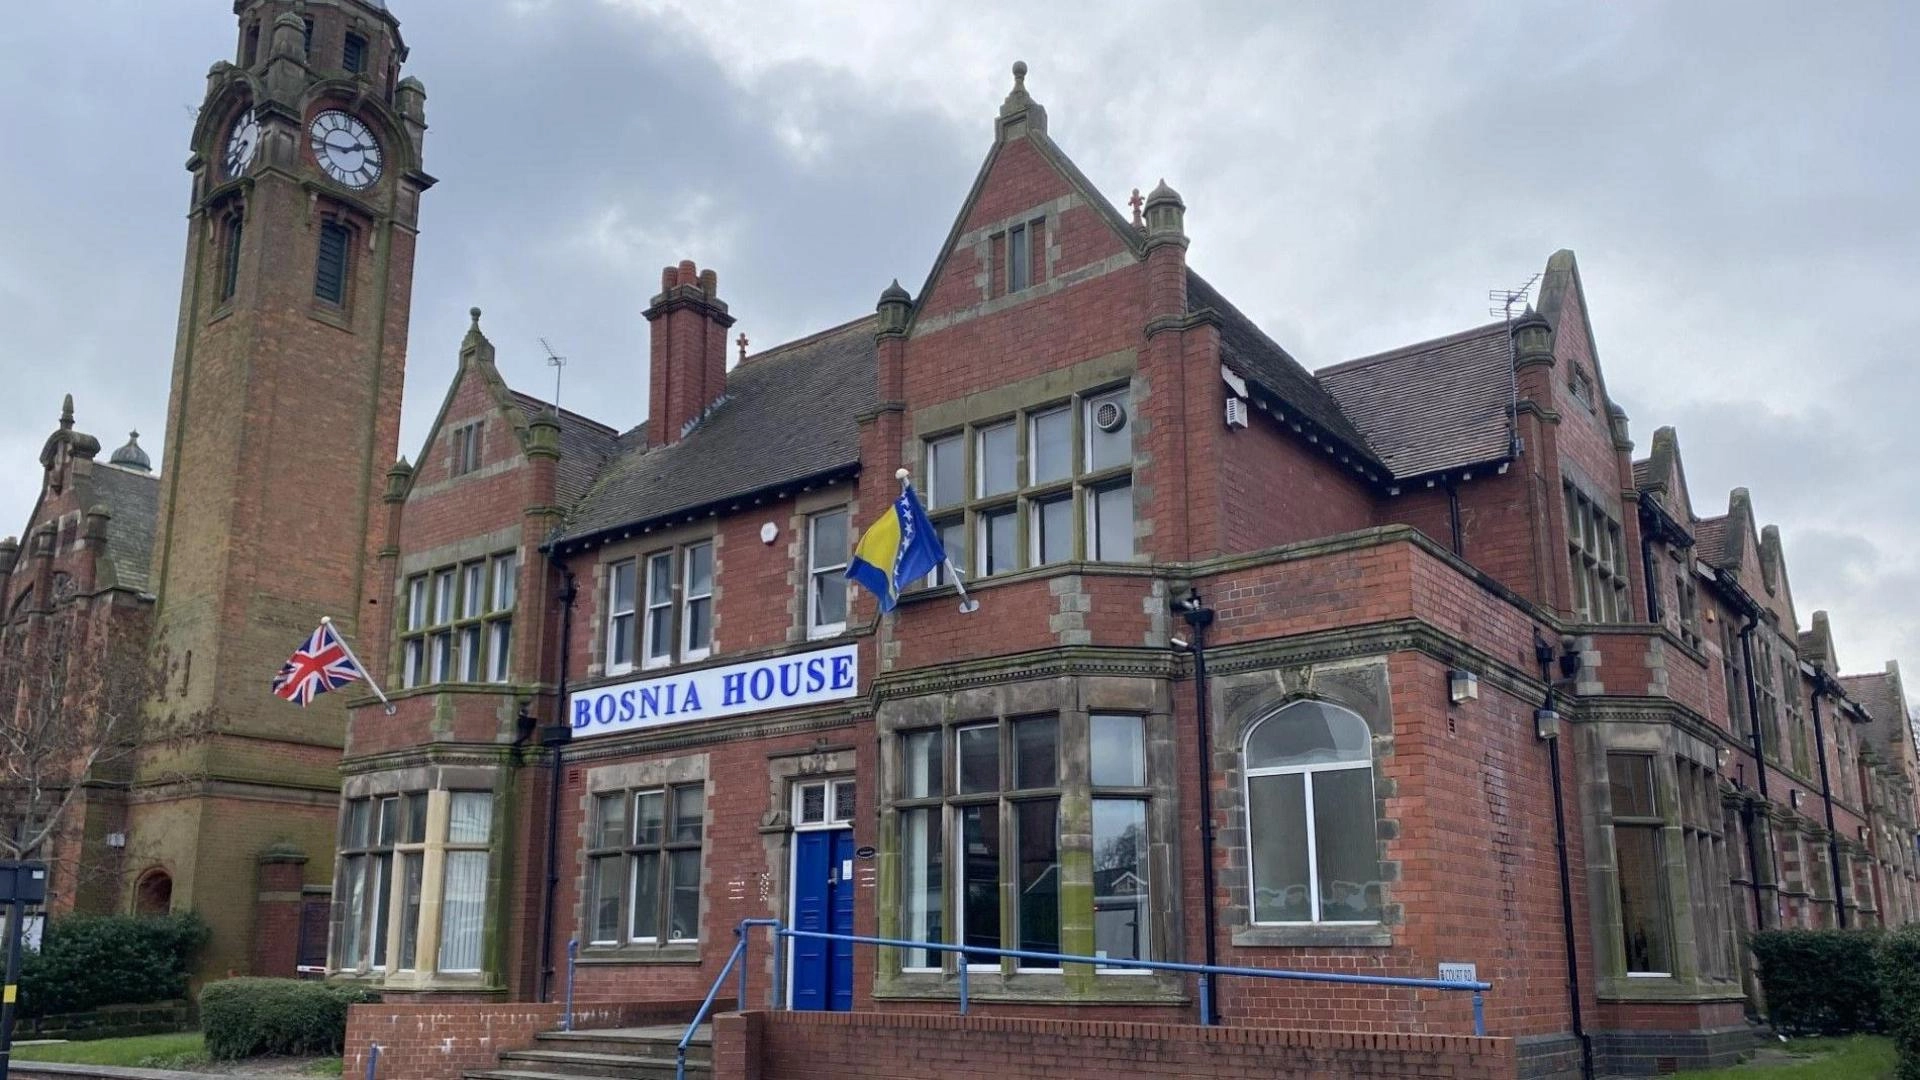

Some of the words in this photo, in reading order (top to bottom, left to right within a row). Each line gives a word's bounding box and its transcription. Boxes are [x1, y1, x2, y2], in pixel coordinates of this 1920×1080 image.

[573, 680, 702, 729] BOSNIA
[721, 654, 854, 707] HOUSE
[1445, 969, 1463, 982] COURT
